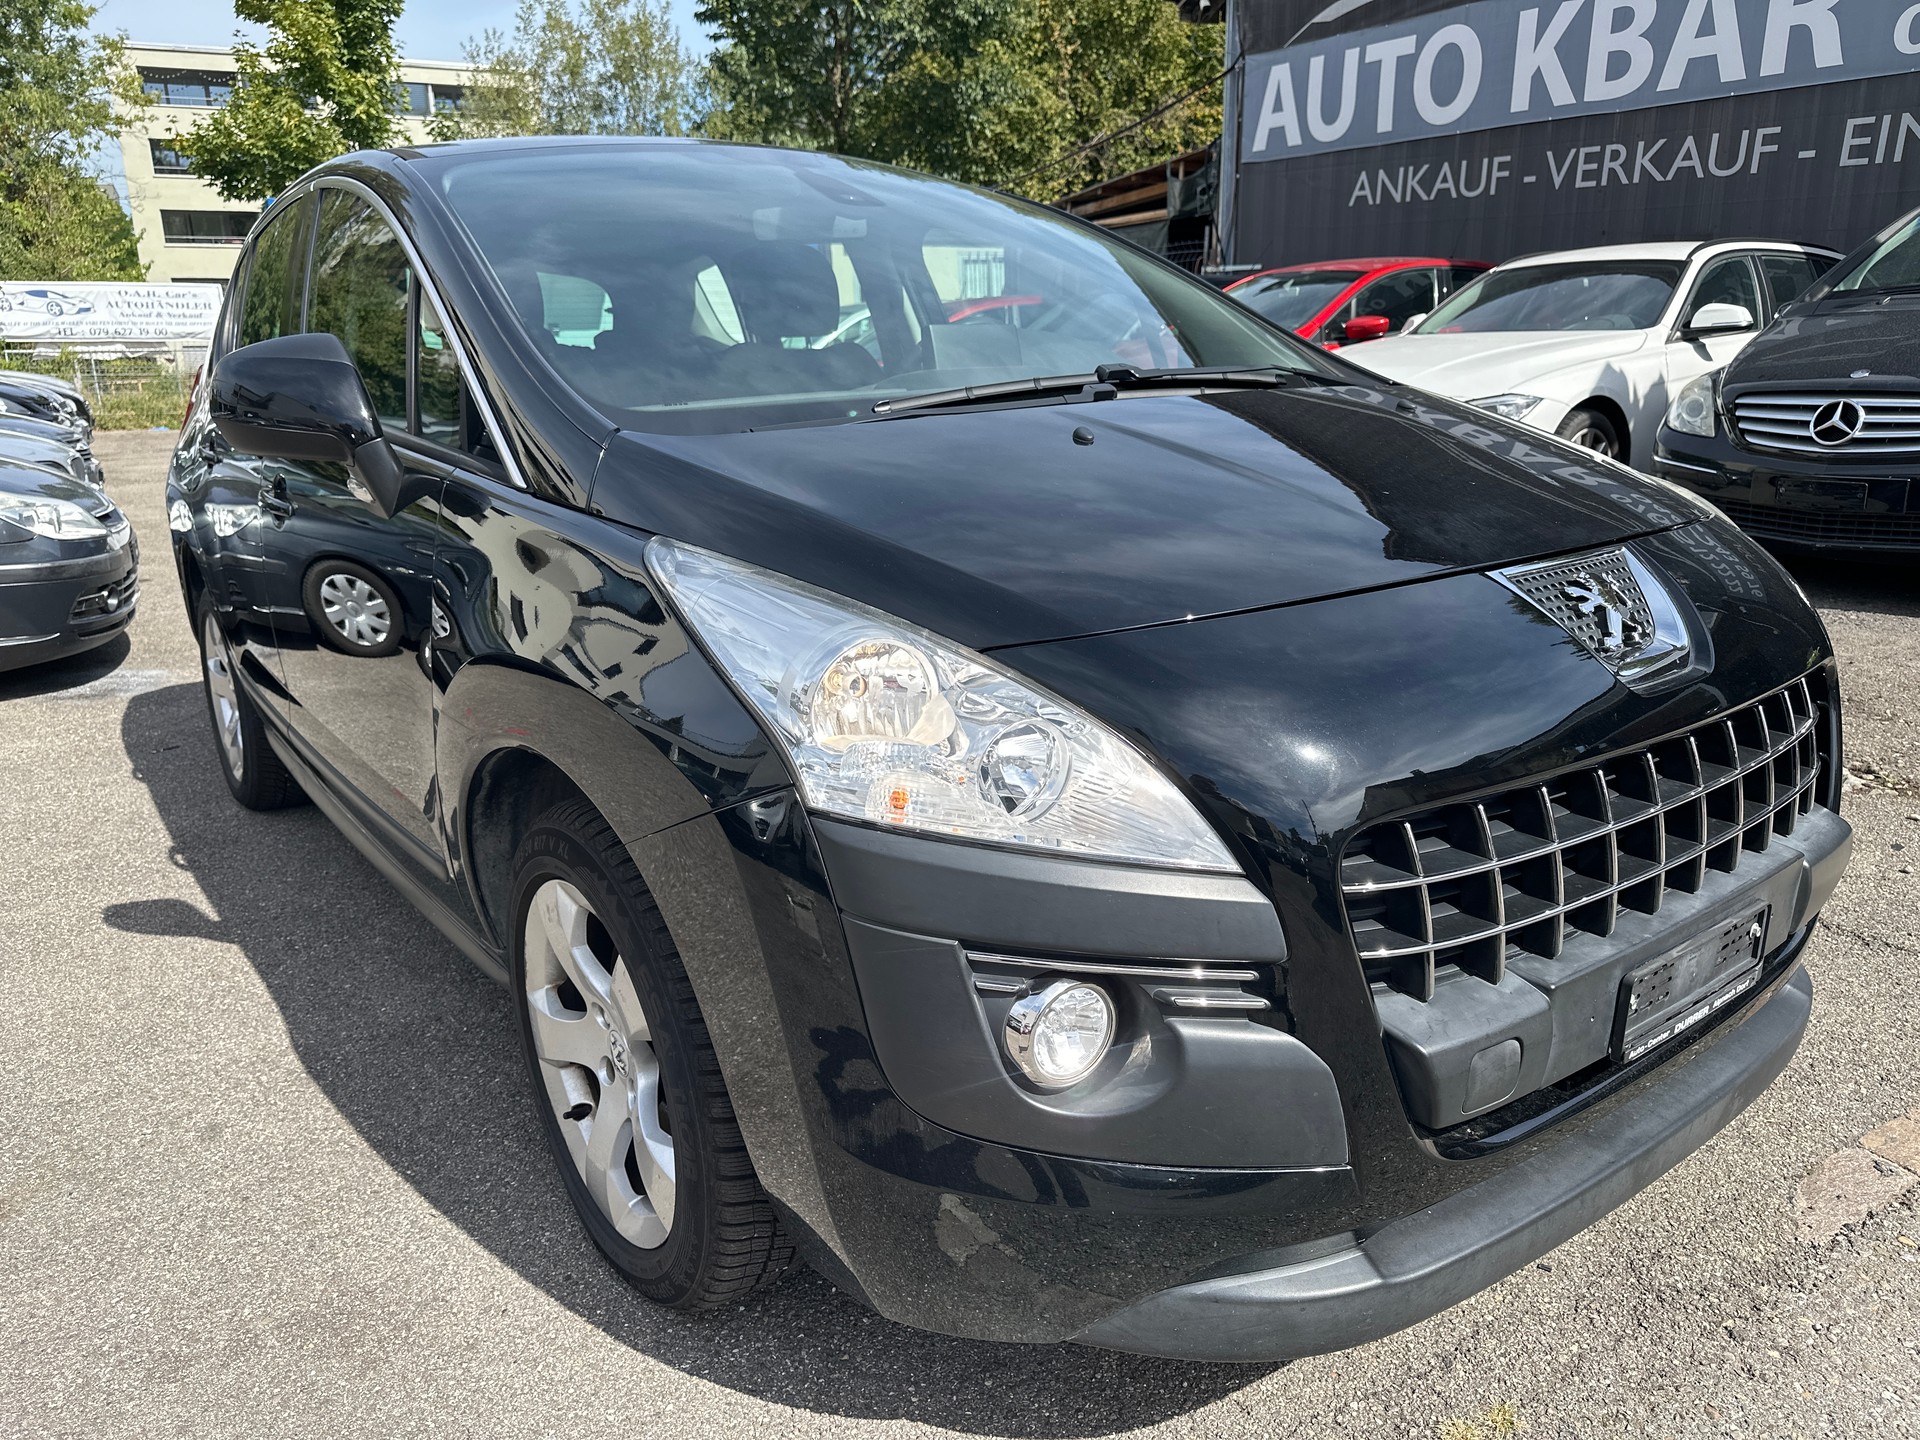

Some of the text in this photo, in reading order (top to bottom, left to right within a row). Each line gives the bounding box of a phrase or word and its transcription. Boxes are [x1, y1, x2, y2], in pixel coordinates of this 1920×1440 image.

[1252, 23, 1482, 153] AUTO
[1510, 0, 1844, 114] KBAR
[1348, 155, 1512, 207] ANKAUF
[1546, 126, 1783, 190] VERKAUF
[106, 300, 213, 310] AUTOHÄNDLER
[119, 311, 152, 319] Ankauf
[166, 311, 203, 319] Verkauf
[88, 327, 109, 337] 079
[114, 327, 133, 337] 627
[138, 328, 150, 337] 19
[154, 327, 169, 337] 00
[534, 834, 547, 851] R17
[557, 839, 569, 861] XL
[1628, 1030, 1671, 1060] Auto-Center
[1674, 1005, 1710, 1034] DURRER
[1736, 979, 1750, 994] Dorf
